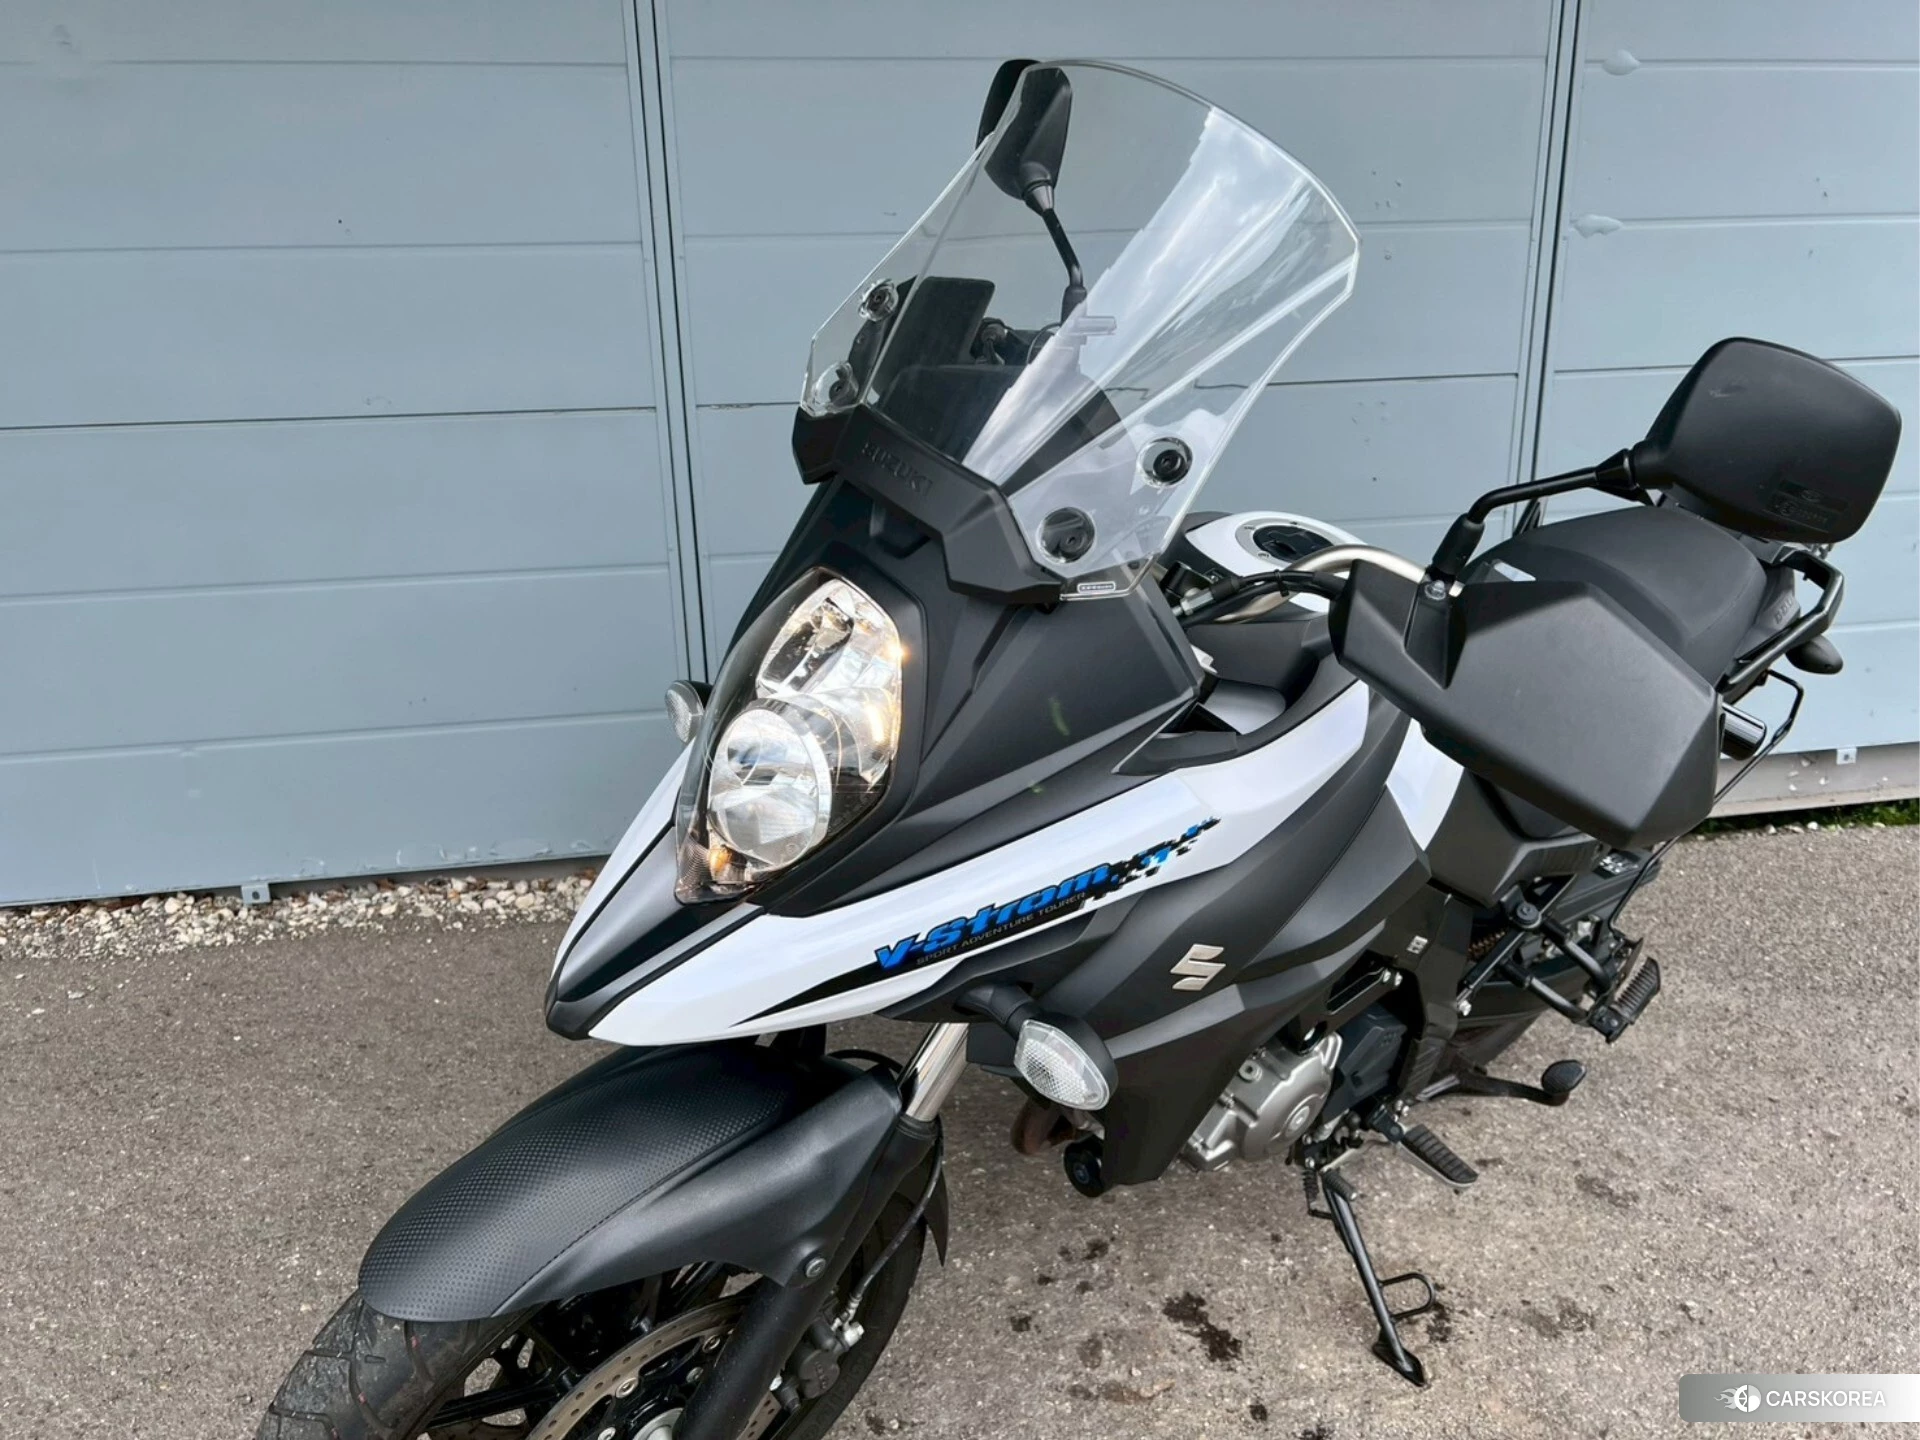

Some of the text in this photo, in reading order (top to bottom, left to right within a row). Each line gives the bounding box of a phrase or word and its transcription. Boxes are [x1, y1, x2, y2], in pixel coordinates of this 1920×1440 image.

[916, 891, 1087, 966] SPORT ADVENTURE TOURER
